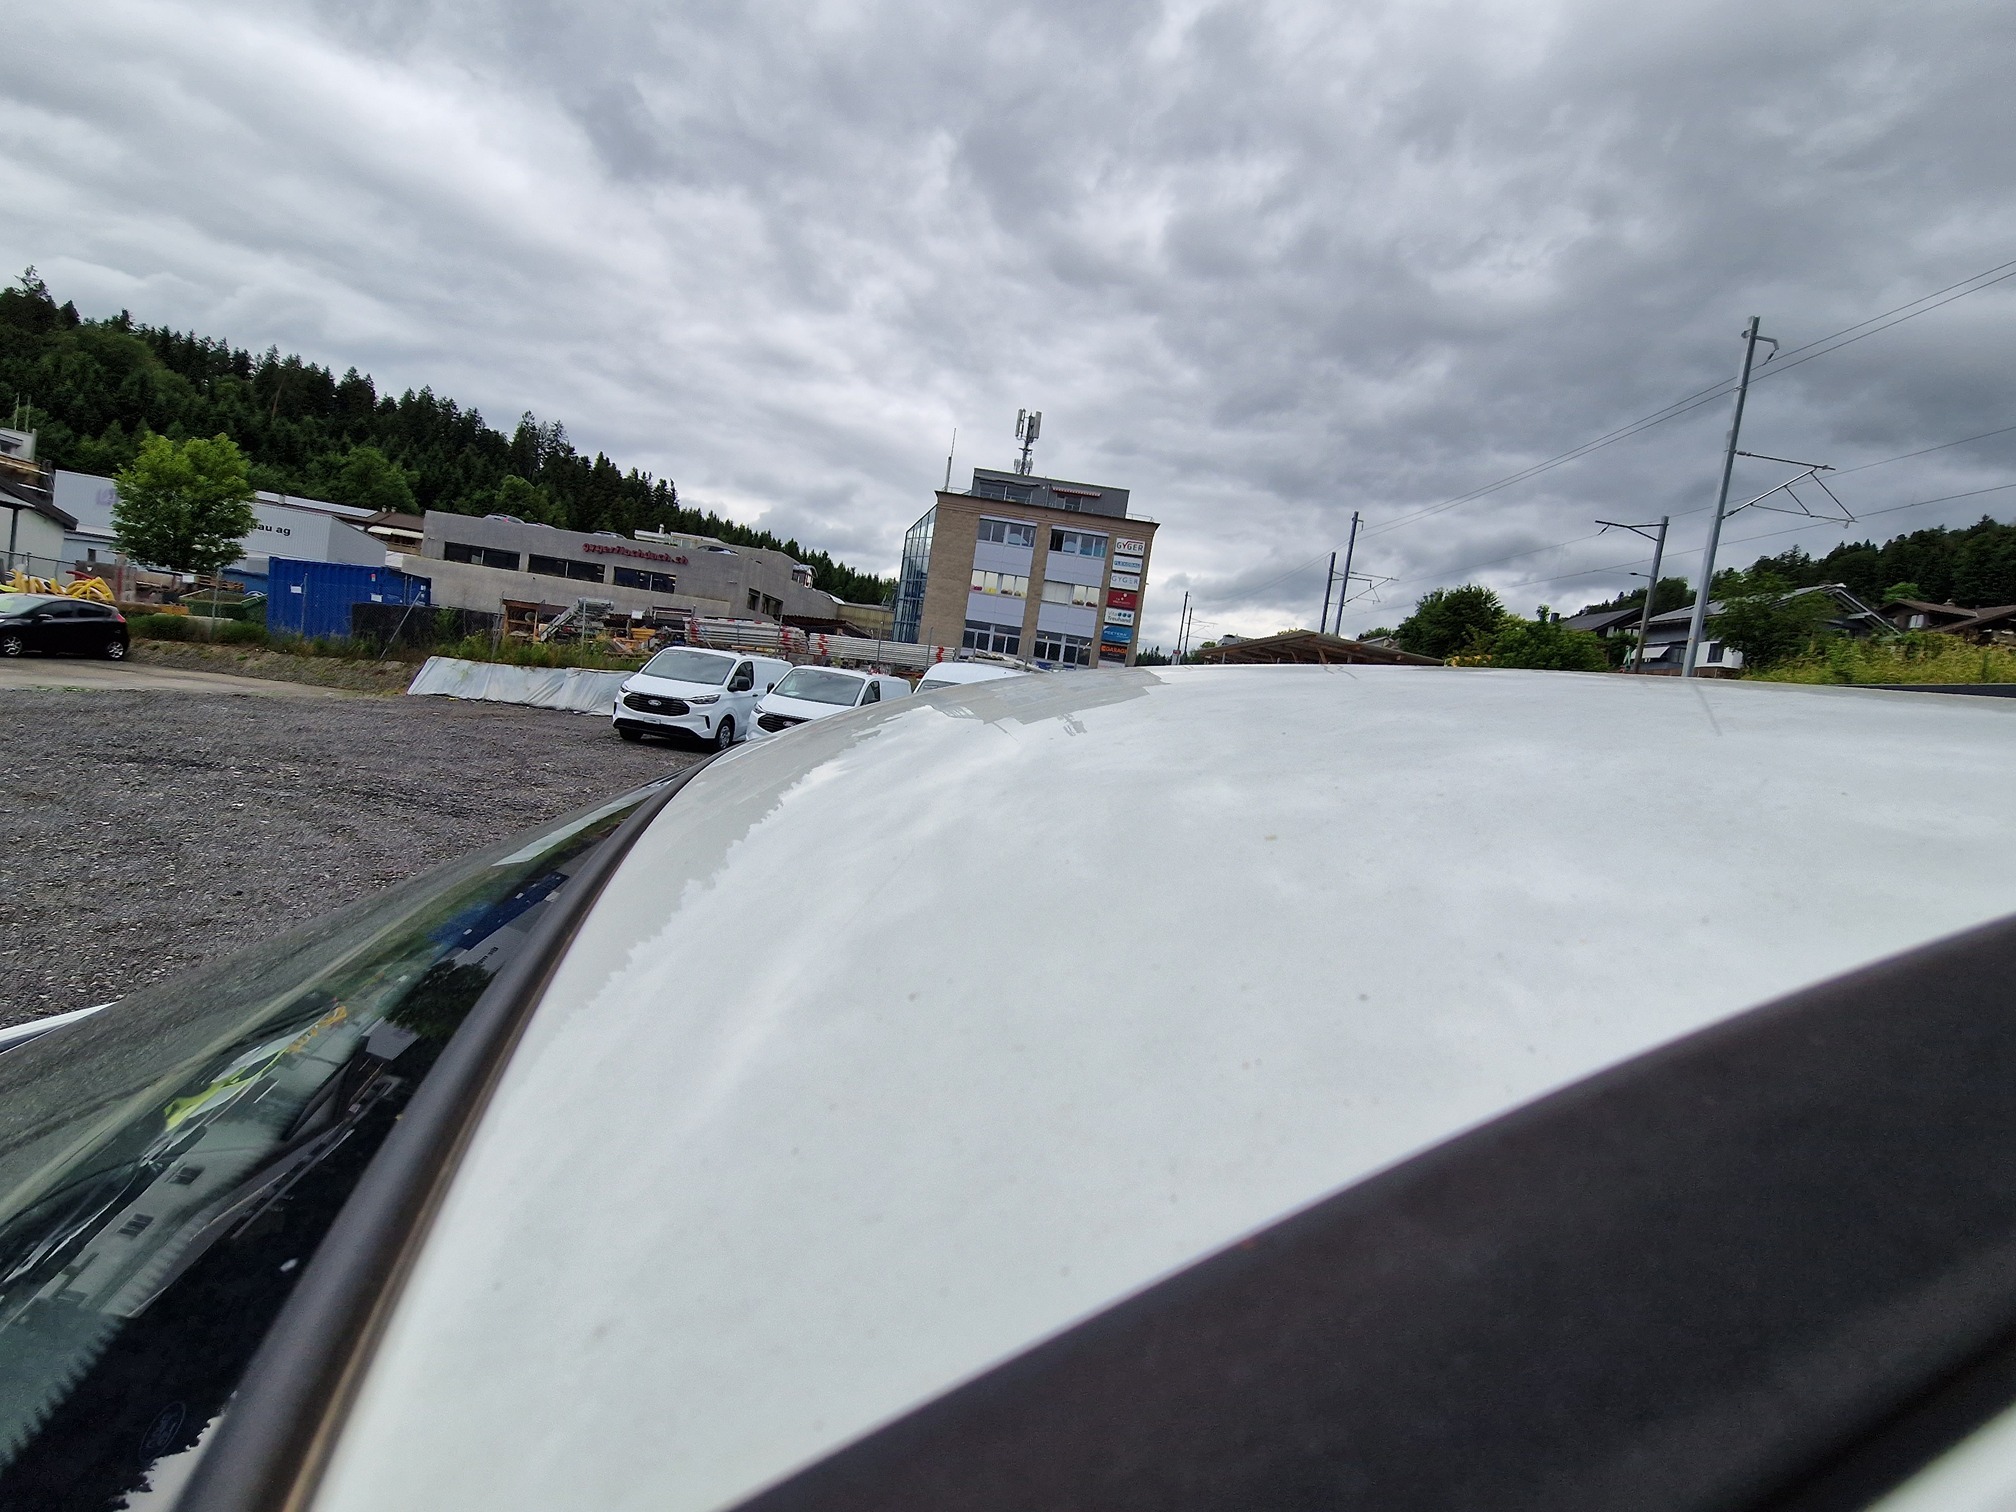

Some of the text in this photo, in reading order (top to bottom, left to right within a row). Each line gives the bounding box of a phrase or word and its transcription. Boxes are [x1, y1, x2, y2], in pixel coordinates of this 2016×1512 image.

[275, 526, 291, 537] ag
[1116, 541, 1144, 552] GYGER
[1111, 575, 1139, 585] GYGER
[1107, 615, 1132, 623] Treuhand
